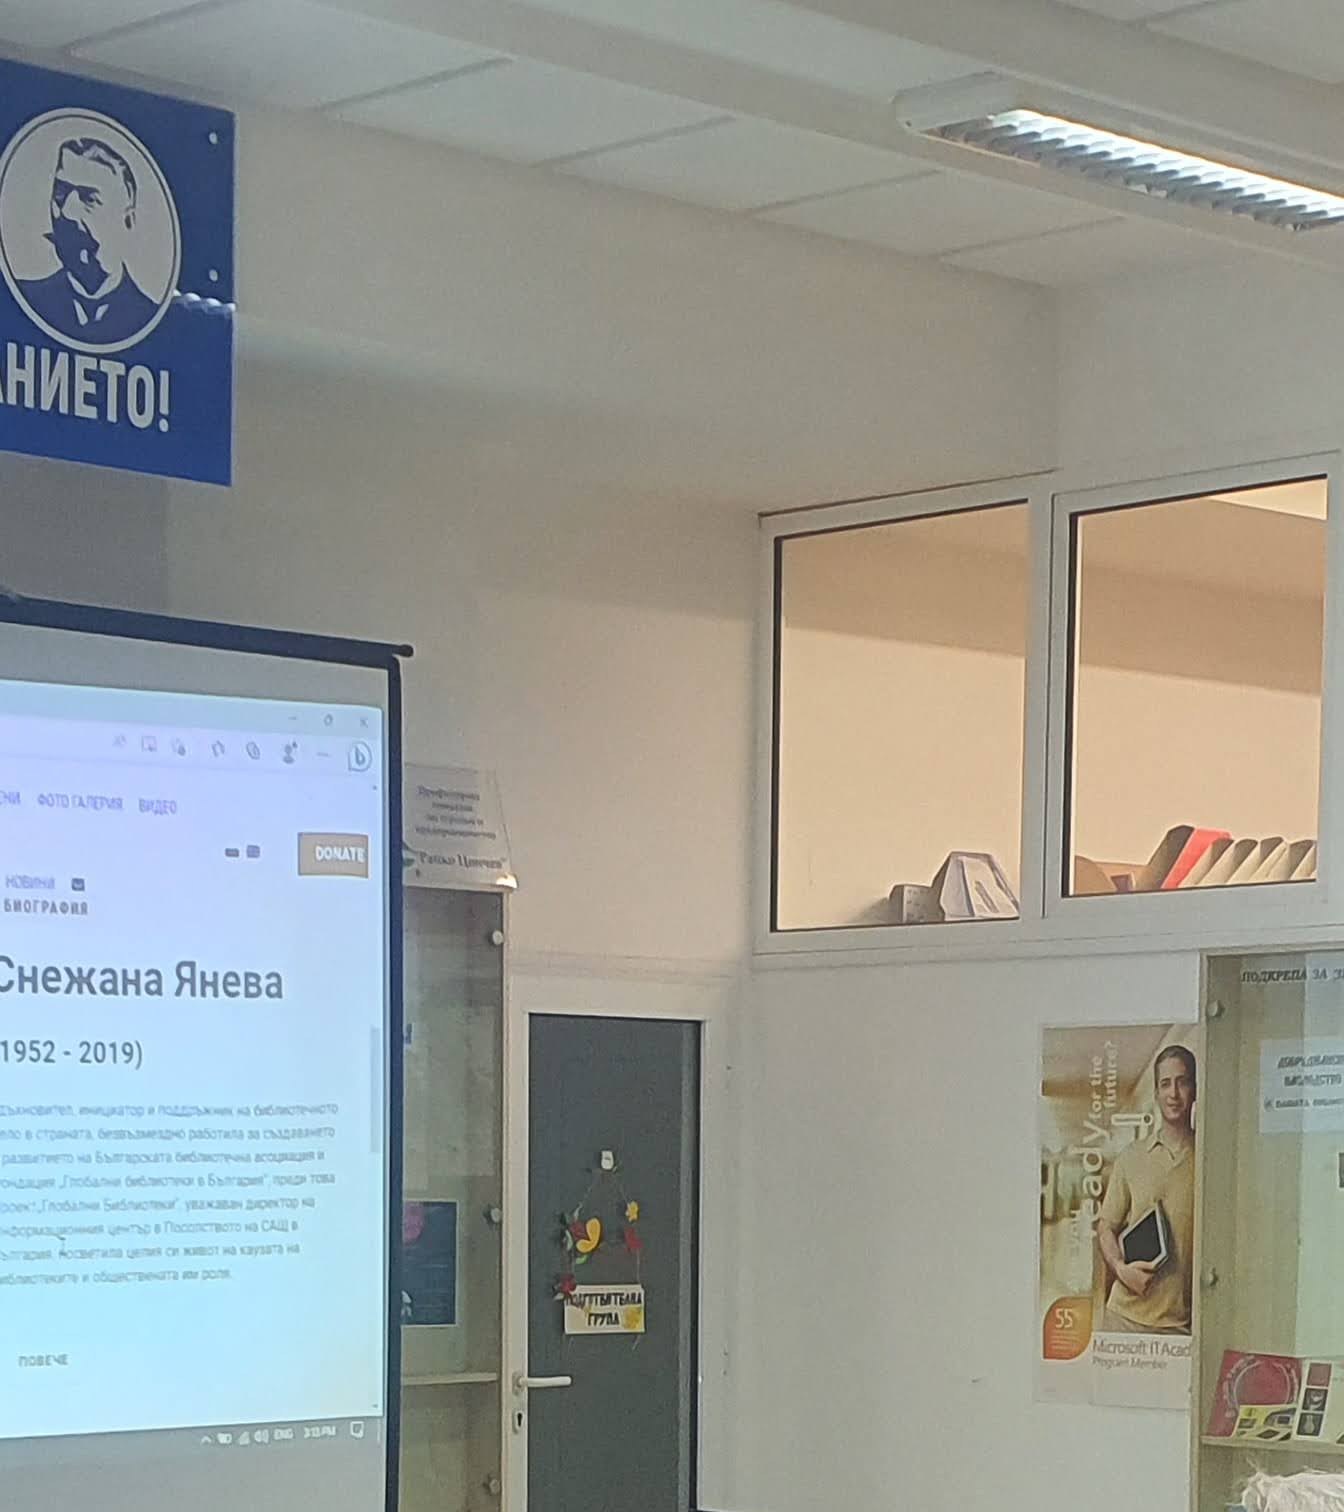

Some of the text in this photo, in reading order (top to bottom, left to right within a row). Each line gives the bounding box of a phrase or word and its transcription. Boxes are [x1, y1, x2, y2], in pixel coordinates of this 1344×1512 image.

[37, 792, 70, 809] ФОТО
[71, 794, 123, 812] ГАЛЕРИЯ
[138, 798, 177, 815] ВИДЕО
[314, 844, 366, 864] DONATE
[5, 873, 56, 891] НОВИНИ
[4, 898, 88, 915] БИОГРАФИЯ
[174, 960, 283, 999] Янева
[1240, 967, 1307, 983] ПОДКРЕПА
[1312, 969, 1328, 981] ЗА
[78, 1039, 143, 1070] 2019)
[1088, 1056, 1103, 1086] the
[1089, 1092, 1103, 1119] for
[588, 1312, 620, 1327] ГРУПА
[1093, 1338, 1147, 1355] Microsoft
[18, 1353, 69, 1367] ПОВЕЧЕ
